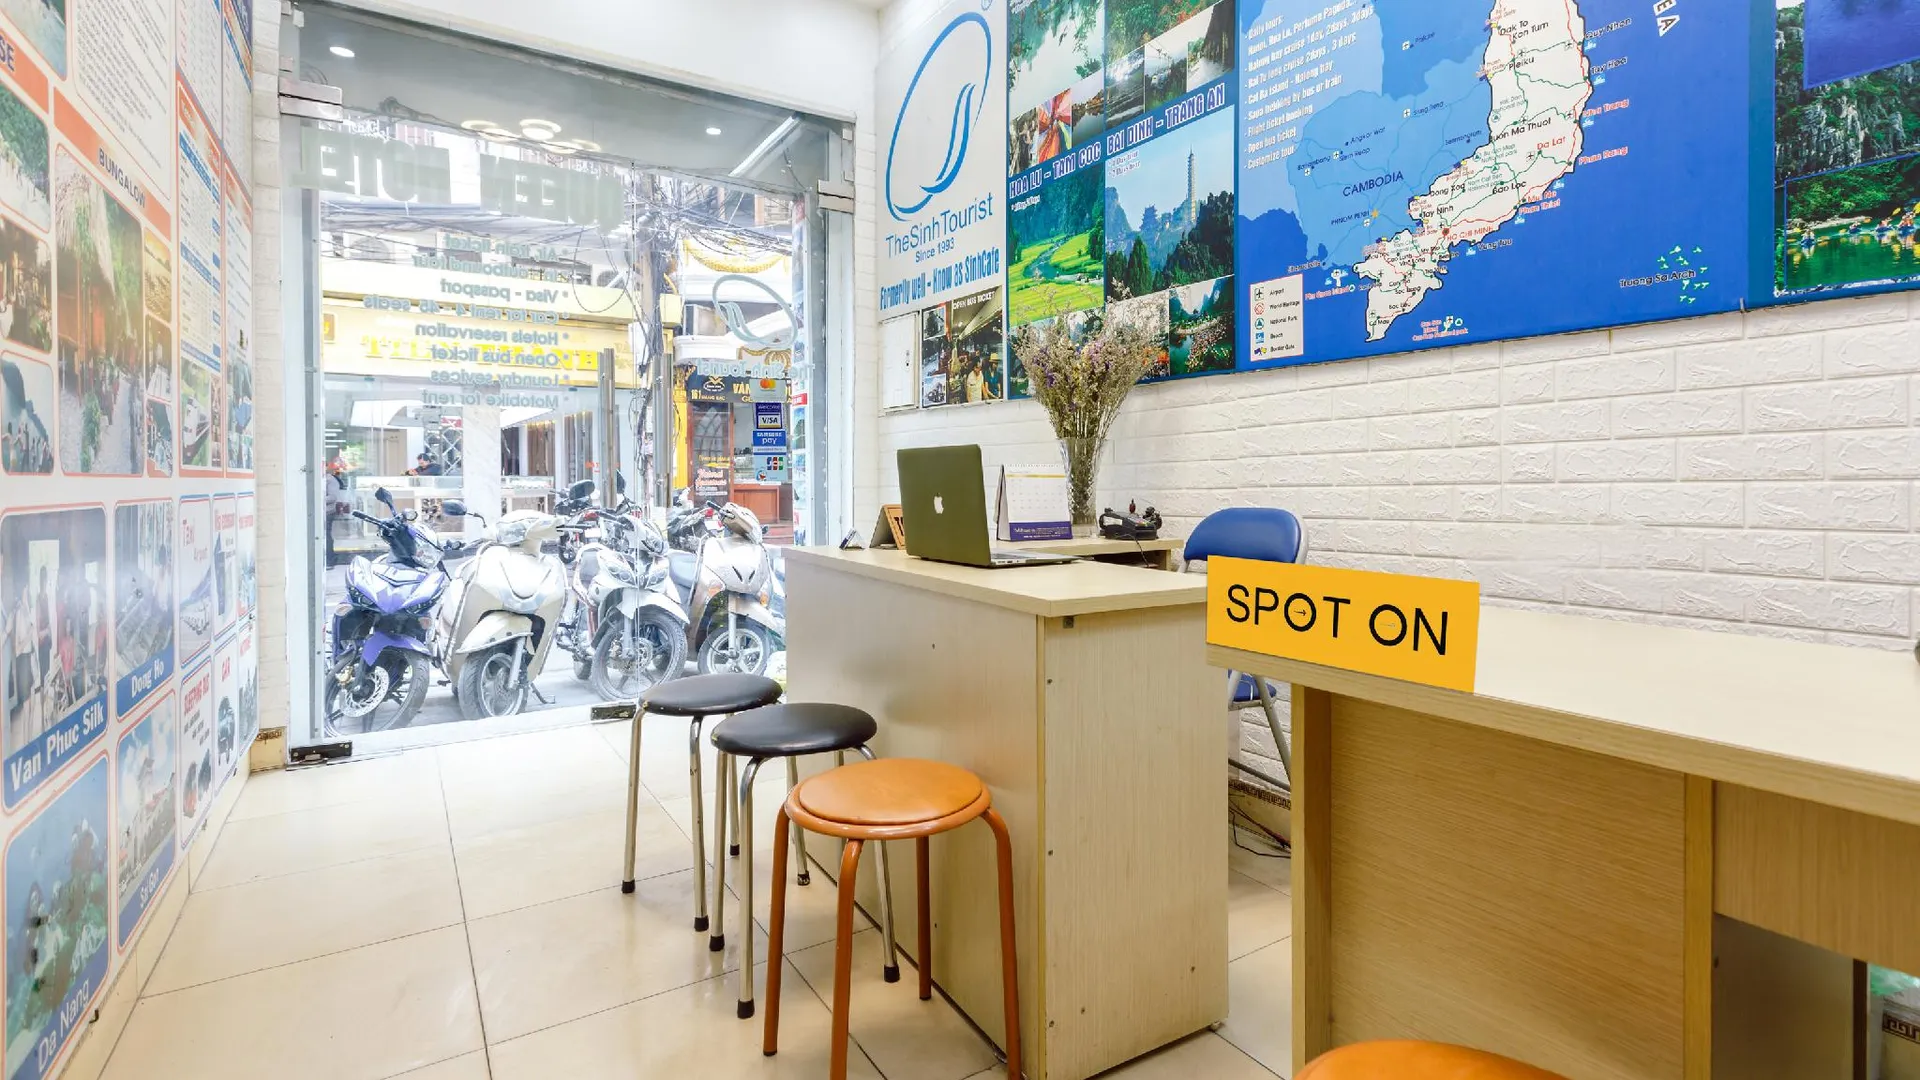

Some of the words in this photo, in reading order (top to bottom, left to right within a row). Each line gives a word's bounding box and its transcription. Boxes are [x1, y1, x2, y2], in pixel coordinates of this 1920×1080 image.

[1248, 26, 1265, 41] Daily
[1500, 25, 1517, 36] Dak
[1606, 17, 1632, 33] Nhon
[1512, 30, 1529, 40] Kon
[1284, 56, 1305, 73] cruise
[1106, 134, 1125, 157] BAI
[1127, 115, 1154, 147] DINH
[1165, 94, 1205, 129] TRANG
[1207, 81, 1226, 112] AN
[1277, 126, 1297, 143] ticket
[1511, 126, 1526, 138] Ma
[1528, 118, 1552, 132] Thuot
[1537, 142, 1551, 150] Da
[1552, 136, 1566, 148] Lat
[1009, 177, 1029, 201] HOA
[1053, 153, 1076, 180] TAM
[1078, 141, 1102, 169] COC
[1342, 170, 1404, 198] CAMBODIA
[1436, 204, 1454, 215] Ninh
[1446, 234, 1458, 243] HO
[1473, 225, 1494, 237] MINH
[915, 248, 935, 263] Since
[937, 236, 955, 255] 1993
[762, 437, 778, 445] pay
[1226, 583, 1351, 639] SPOT
[1369, 603, 1448, 656] ON
[10, 753, 43, 795] Van
[46, 726, 81, 773] Phuc
[82, 703, 106, 746] Silk
[38, 1035, 58, 1074] Da
[60, 978, 90, 1041] Nang
